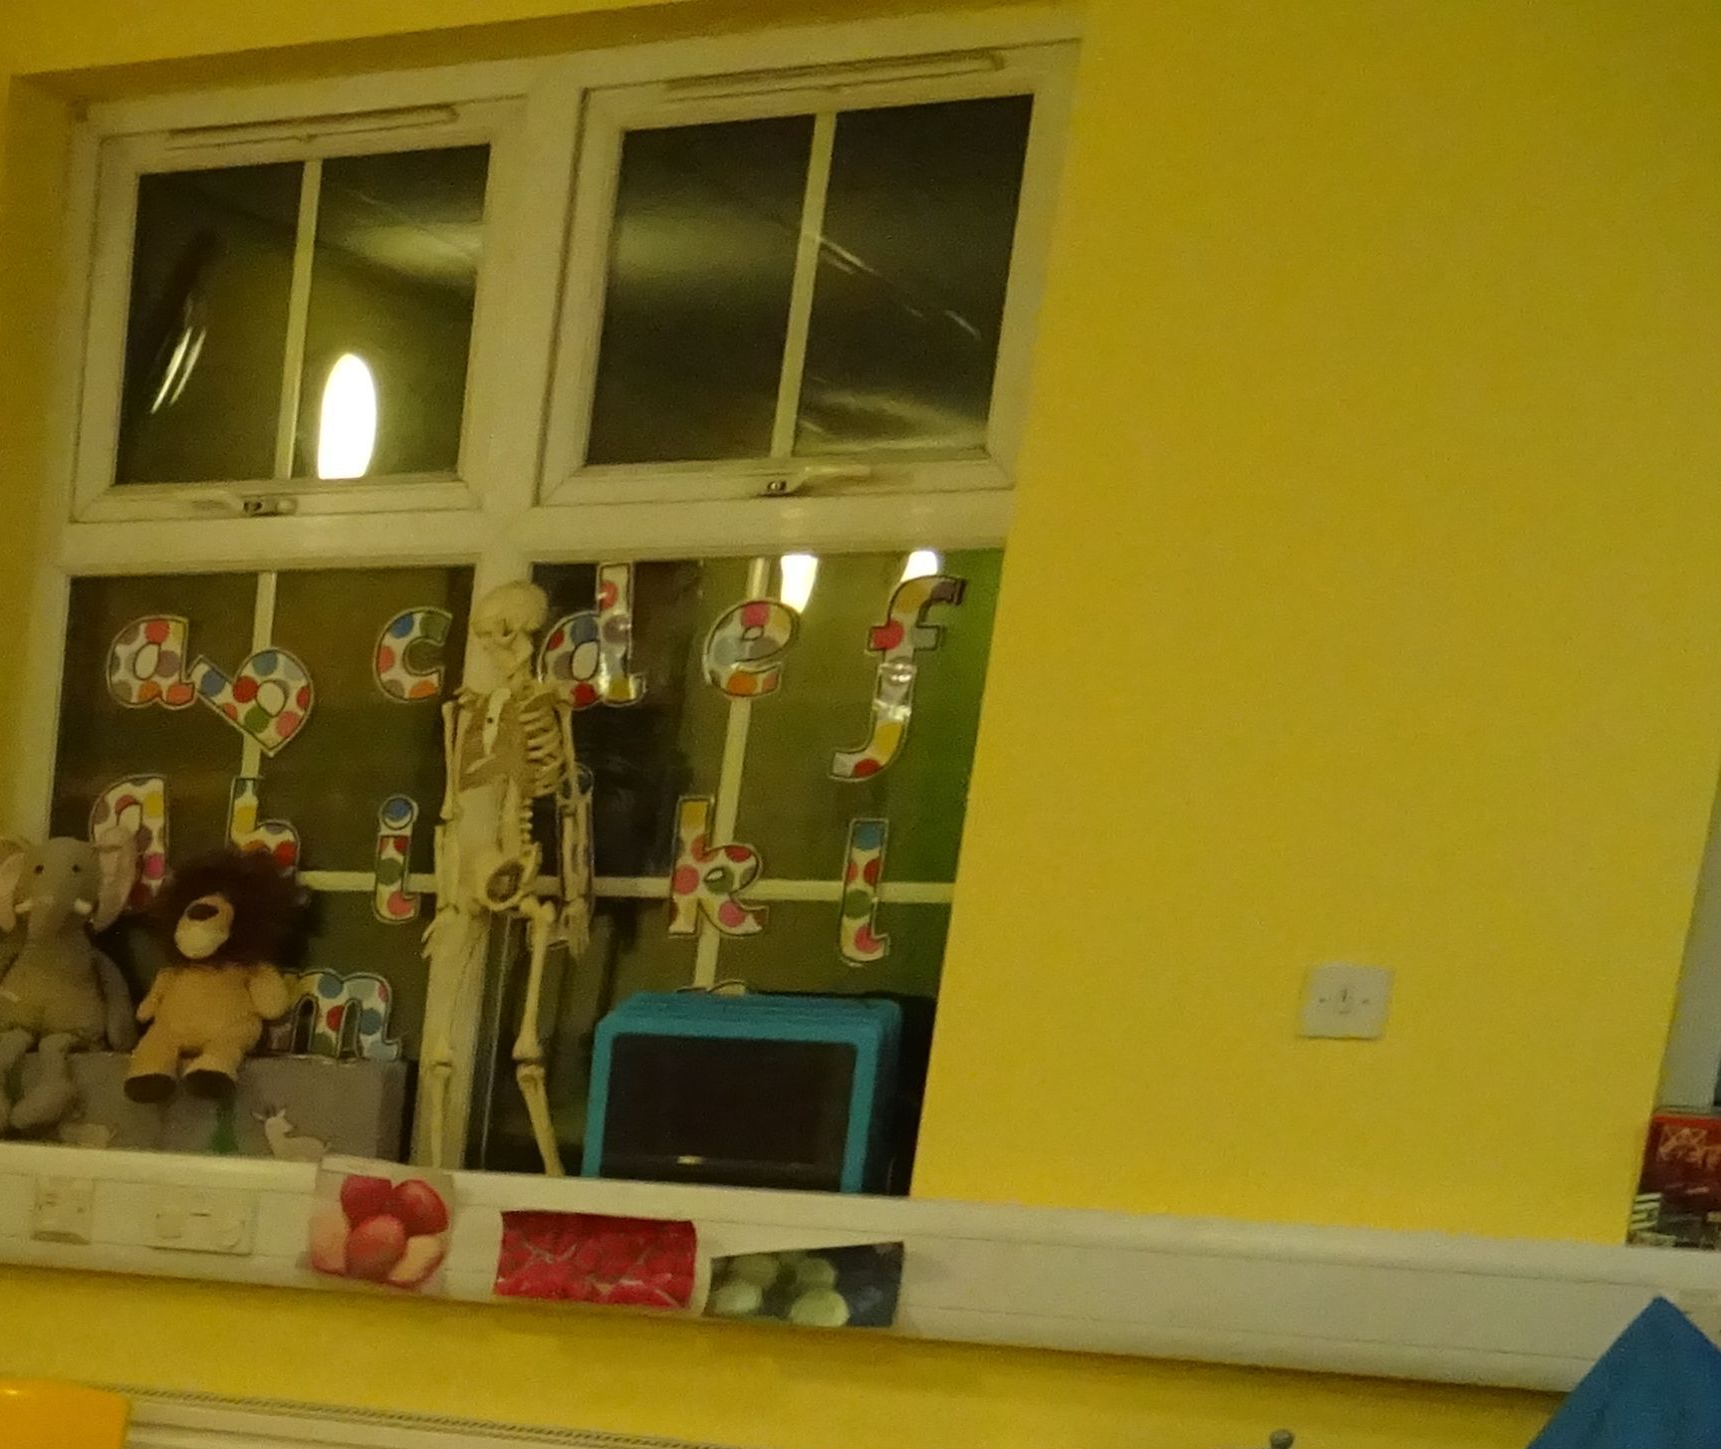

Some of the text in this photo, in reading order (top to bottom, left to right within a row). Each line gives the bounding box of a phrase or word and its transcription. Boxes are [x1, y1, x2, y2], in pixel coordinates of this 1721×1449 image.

[373, 605, 454, 704] c
[537, 563, 649, 709] d
[702, 599, 801, 700] e
[829, 575, 966, 783] f
[668, 795, 769, 939] k
[839, 818, 891, 965] l
